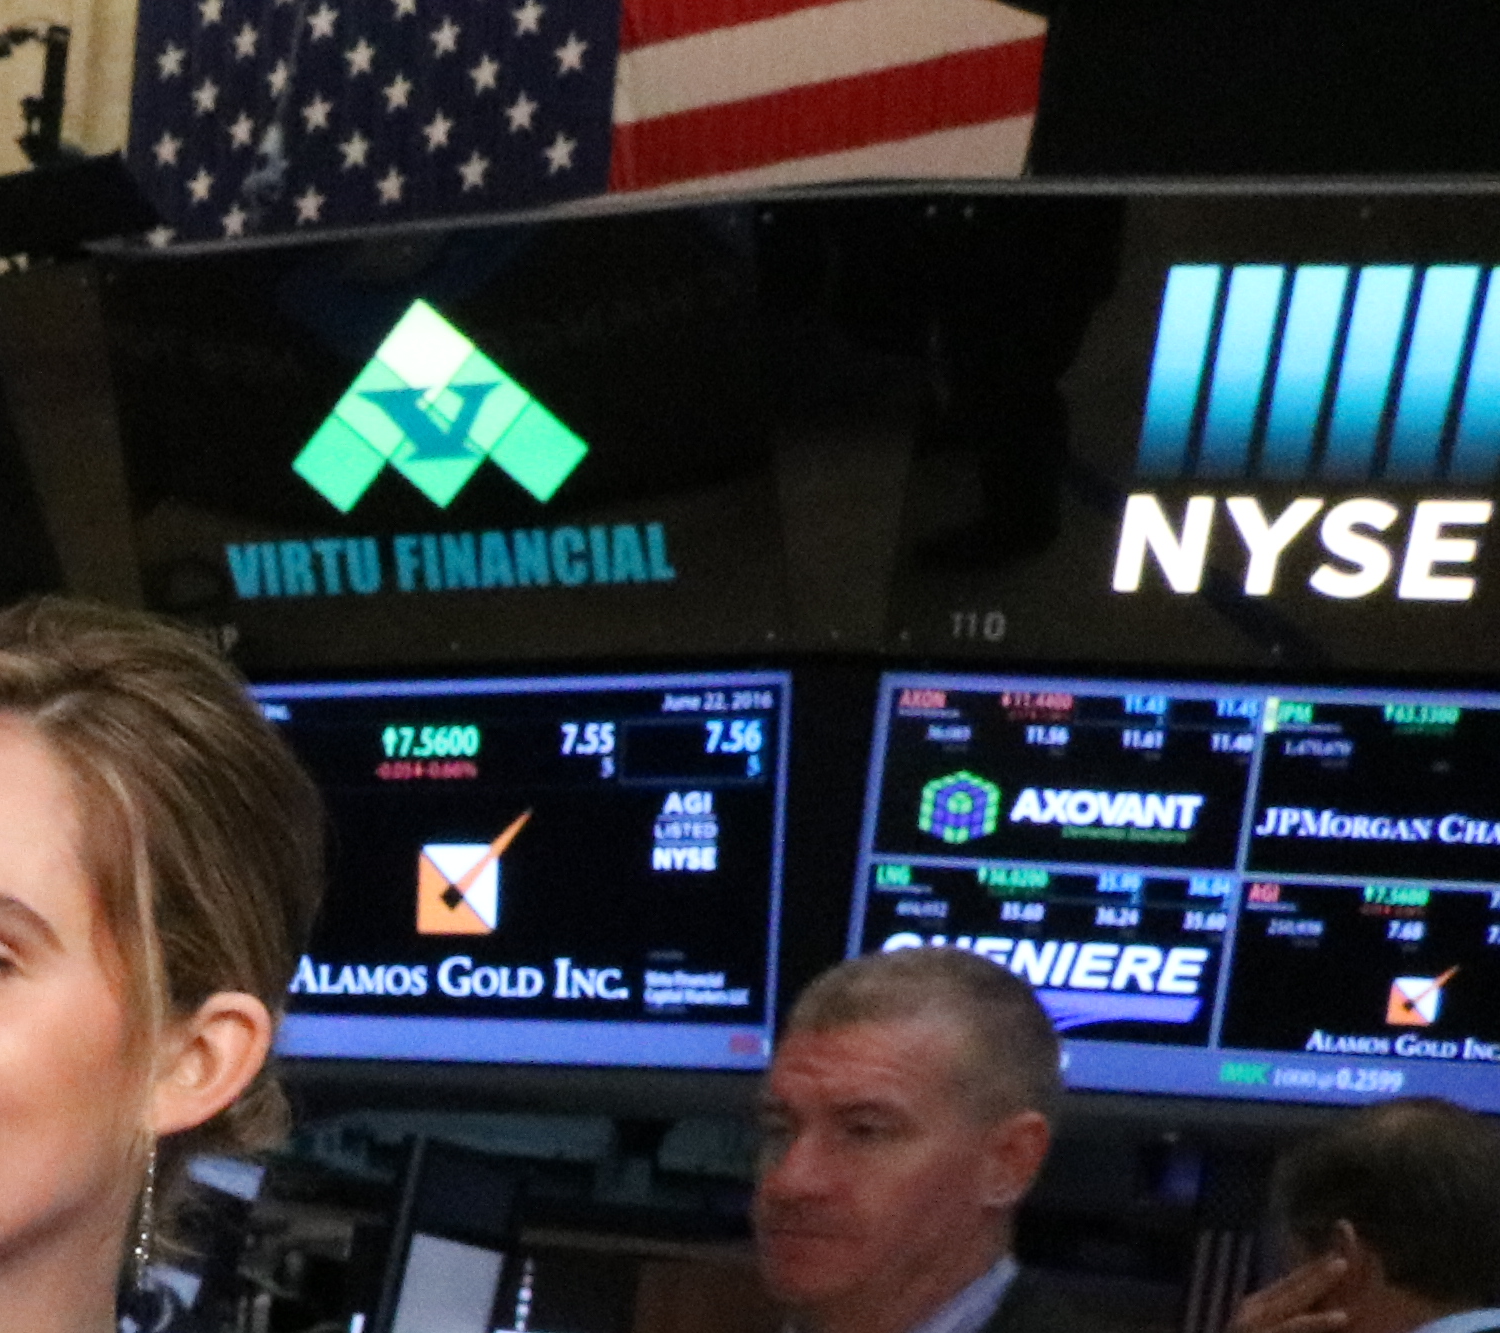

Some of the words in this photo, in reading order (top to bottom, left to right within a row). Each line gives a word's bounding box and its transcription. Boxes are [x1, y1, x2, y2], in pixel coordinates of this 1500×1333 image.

[225, 536, 381, 601] VIRTU
[391, 522, 676, 594] FINANCIAL
[1112, 494, 1494, 602] NYSE
[561, 721, 616, 756] 7.55
[705, 719, 763, 754] 7.56
[663, 790, 713, 816] AGI
[1009, 786, 1206, 831] AXOVANT
[1255, 805, 1433, 842] JPMORGAN
[652, 846, 718, 872] NYSE
[289, 954, 428, 996] ALAMOS
[437, 955, 544, 999] GOLD
[554, 957, 629, 1000] INC.
[882, 932, 1210, 994] ENIERE
